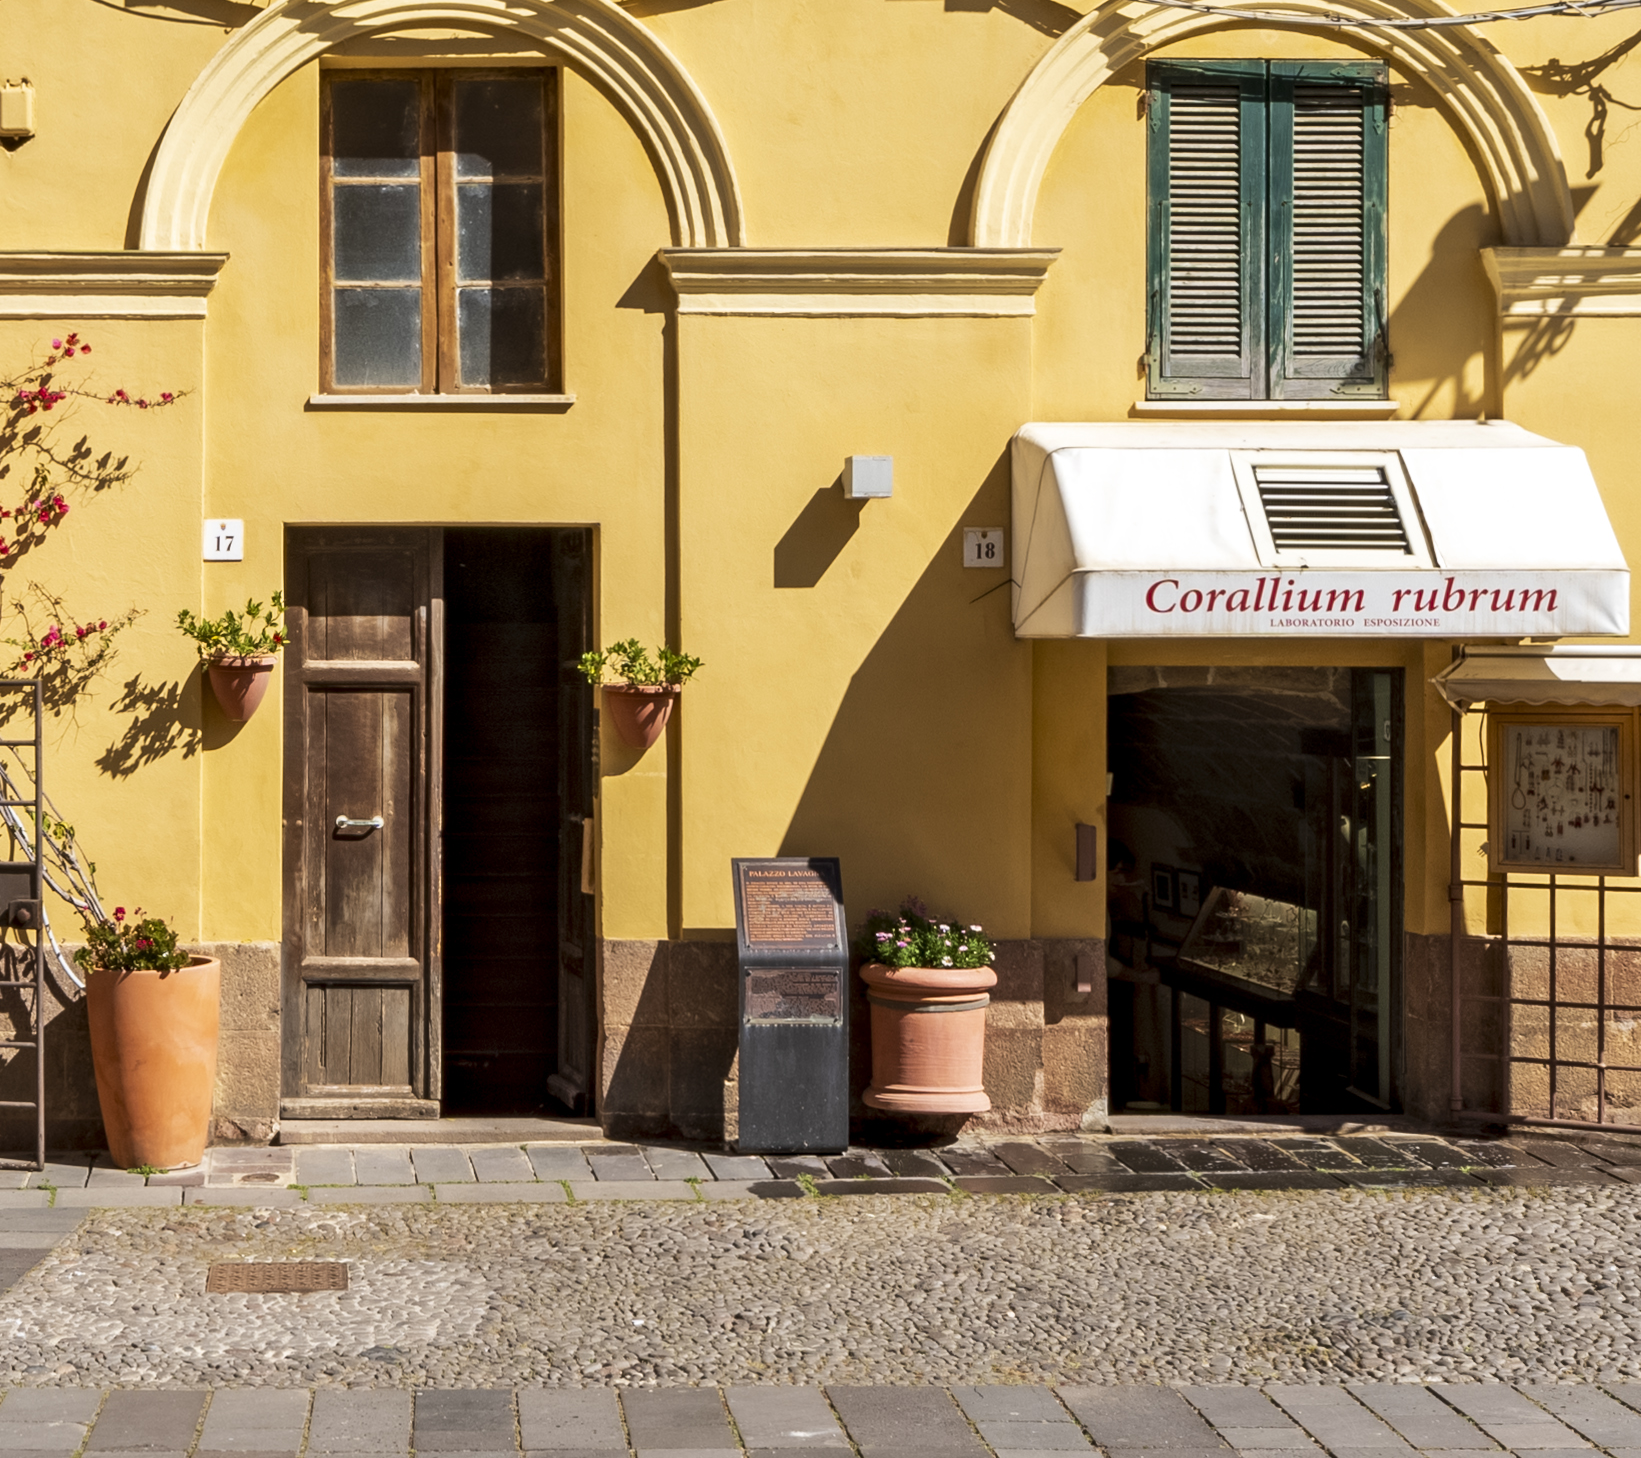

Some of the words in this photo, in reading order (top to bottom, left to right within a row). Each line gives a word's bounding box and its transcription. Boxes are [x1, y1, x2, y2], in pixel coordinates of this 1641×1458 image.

[214, 535, 234, 552] 17
[975, 542, 995, 559] 18
[1145, 577, 1365, 614] Corallium
[1392, 577, 1559, 614] rubrum
[1269, 618, 1355, 628] LABORATORIO
[1363, 618, 1441, 628] ESPOSIZIONE
